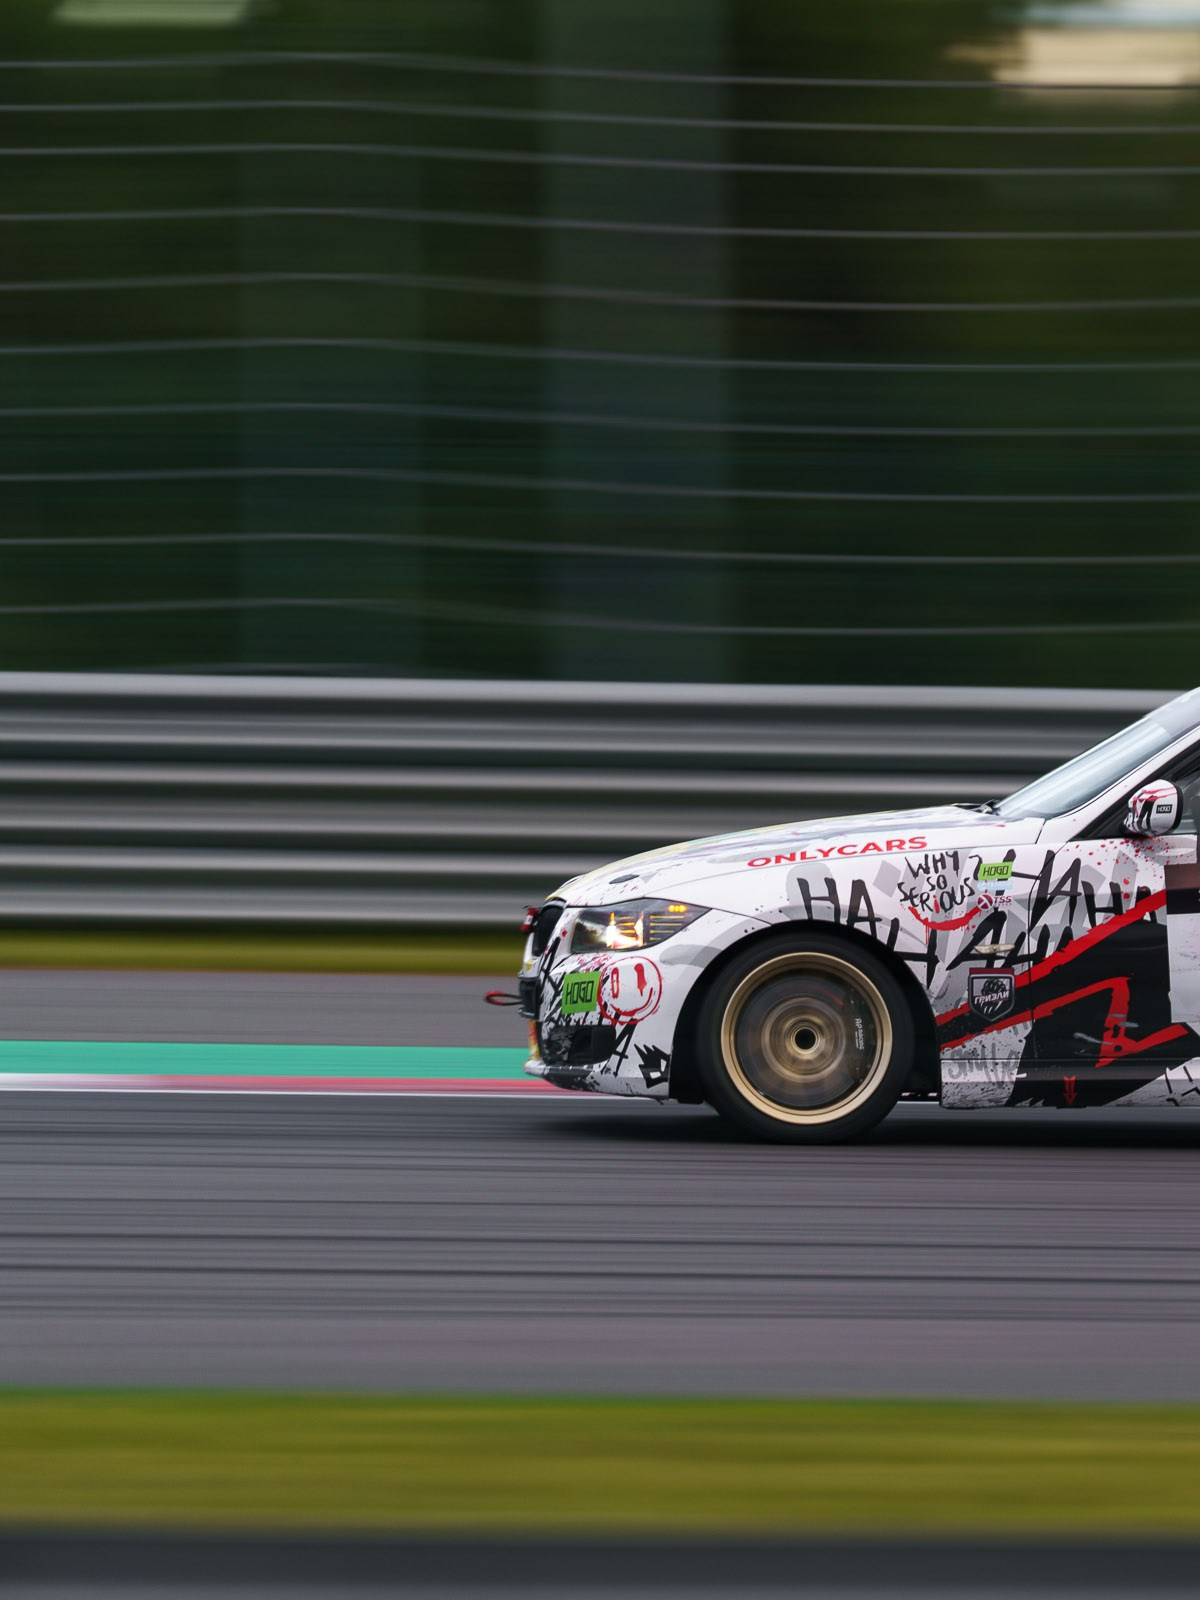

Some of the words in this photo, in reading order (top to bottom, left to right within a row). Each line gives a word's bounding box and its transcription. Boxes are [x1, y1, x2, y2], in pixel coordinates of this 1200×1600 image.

[747, 836, 928, 867] ONLYCARS
[905, 851, 959, 879] WHY
[982, 865, 1009, 876] HOGO
[926, 875, 948, 891] SO
[994, 895, 1012, 904] TSS
[565, 980, 594, 1005] HOGO
[974, 990, 1009, 1005] ГРИЗЛИ
